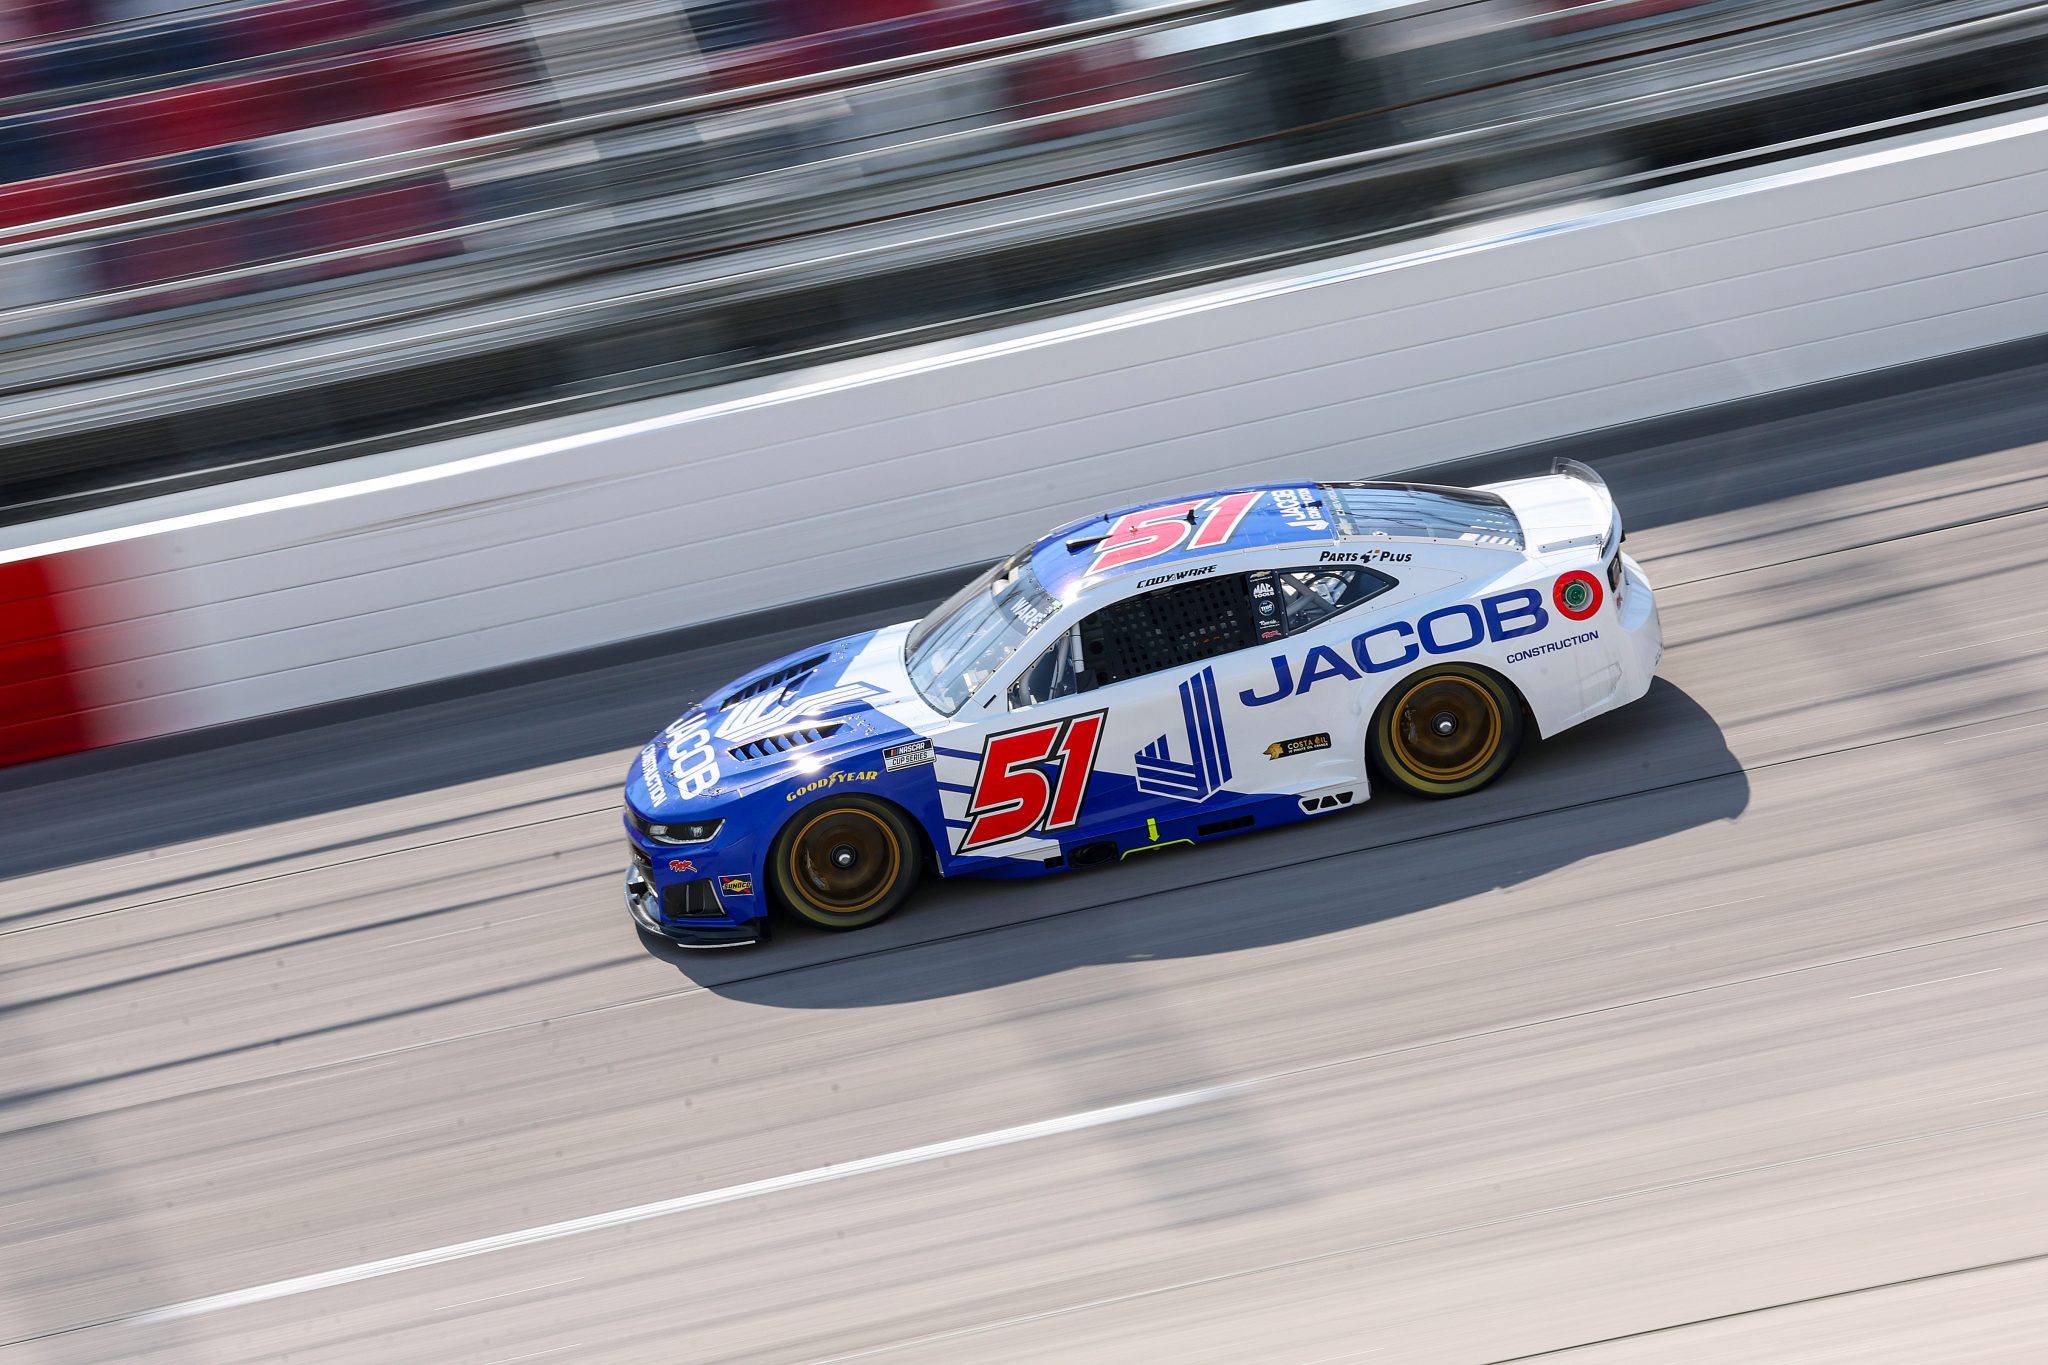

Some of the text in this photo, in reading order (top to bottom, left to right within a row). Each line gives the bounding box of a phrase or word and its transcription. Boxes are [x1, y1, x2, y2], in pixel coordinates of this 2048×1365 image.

[1271, 489, 1306, 520] JACOB
[1083, 490, 1267, 578] 51
[1136, 564, 1218, 588] CODY WARE
[1253, 583, 1275, 595] MAC
[1239, 588, 1550, 707] JACOB
[1506, 630, 1599, 664] CONSTRUCTION
[666, 712, 720, 800] JACOB
[892, 751, 928, 766] CUP SERIES
[899, 742, 925, 754] NASCAR
[1287, 736, 1328, 750] COSTA OIL
[786, 770, 878, 802] GOODYEAR
[957, 707, 1108, 854] 51
[722, 881, 752, 890] SUNOCO
